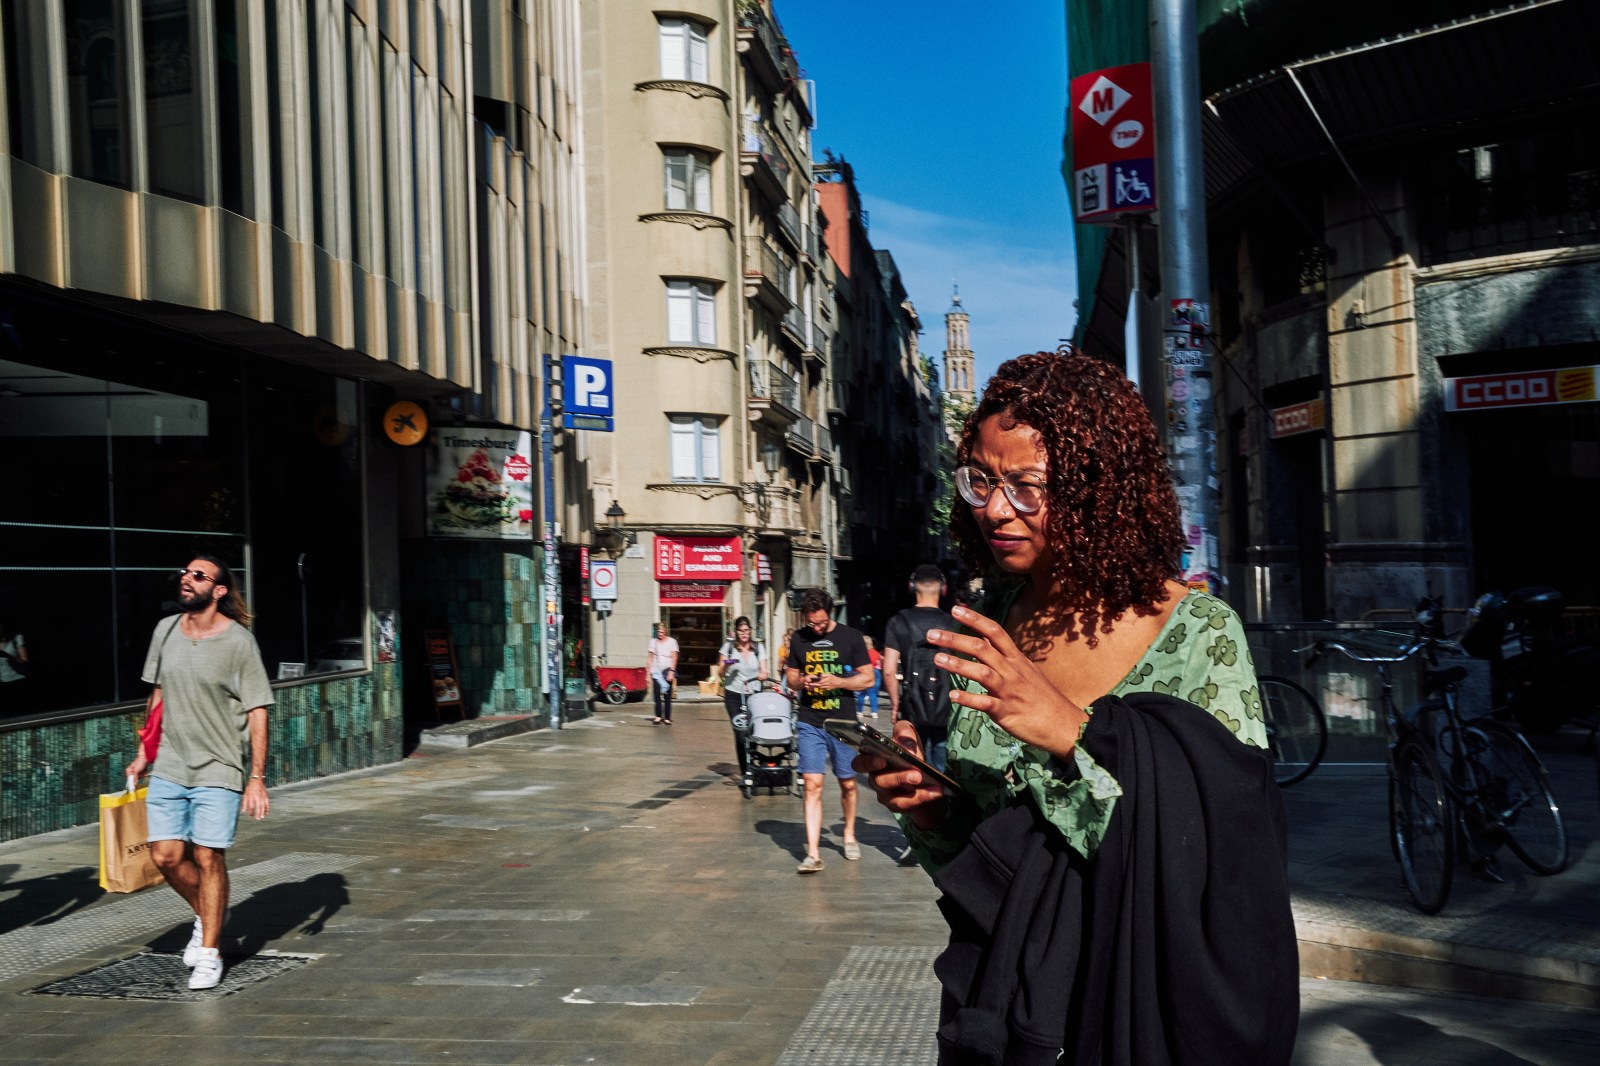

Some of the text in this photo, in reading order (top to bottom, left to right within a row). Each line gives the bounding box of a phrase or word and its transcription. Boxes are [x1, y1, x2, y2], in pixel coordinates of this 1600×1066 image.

[1092, 87, 1114, 115] M
[574, 364, 607, 407] P
[1461, 377, 1549, 403] CCOO
[1275, 409, 1308, 431] CCOO
[805, 650, 839, 663] KEEP
[804, 664, 843, 675] CALM
